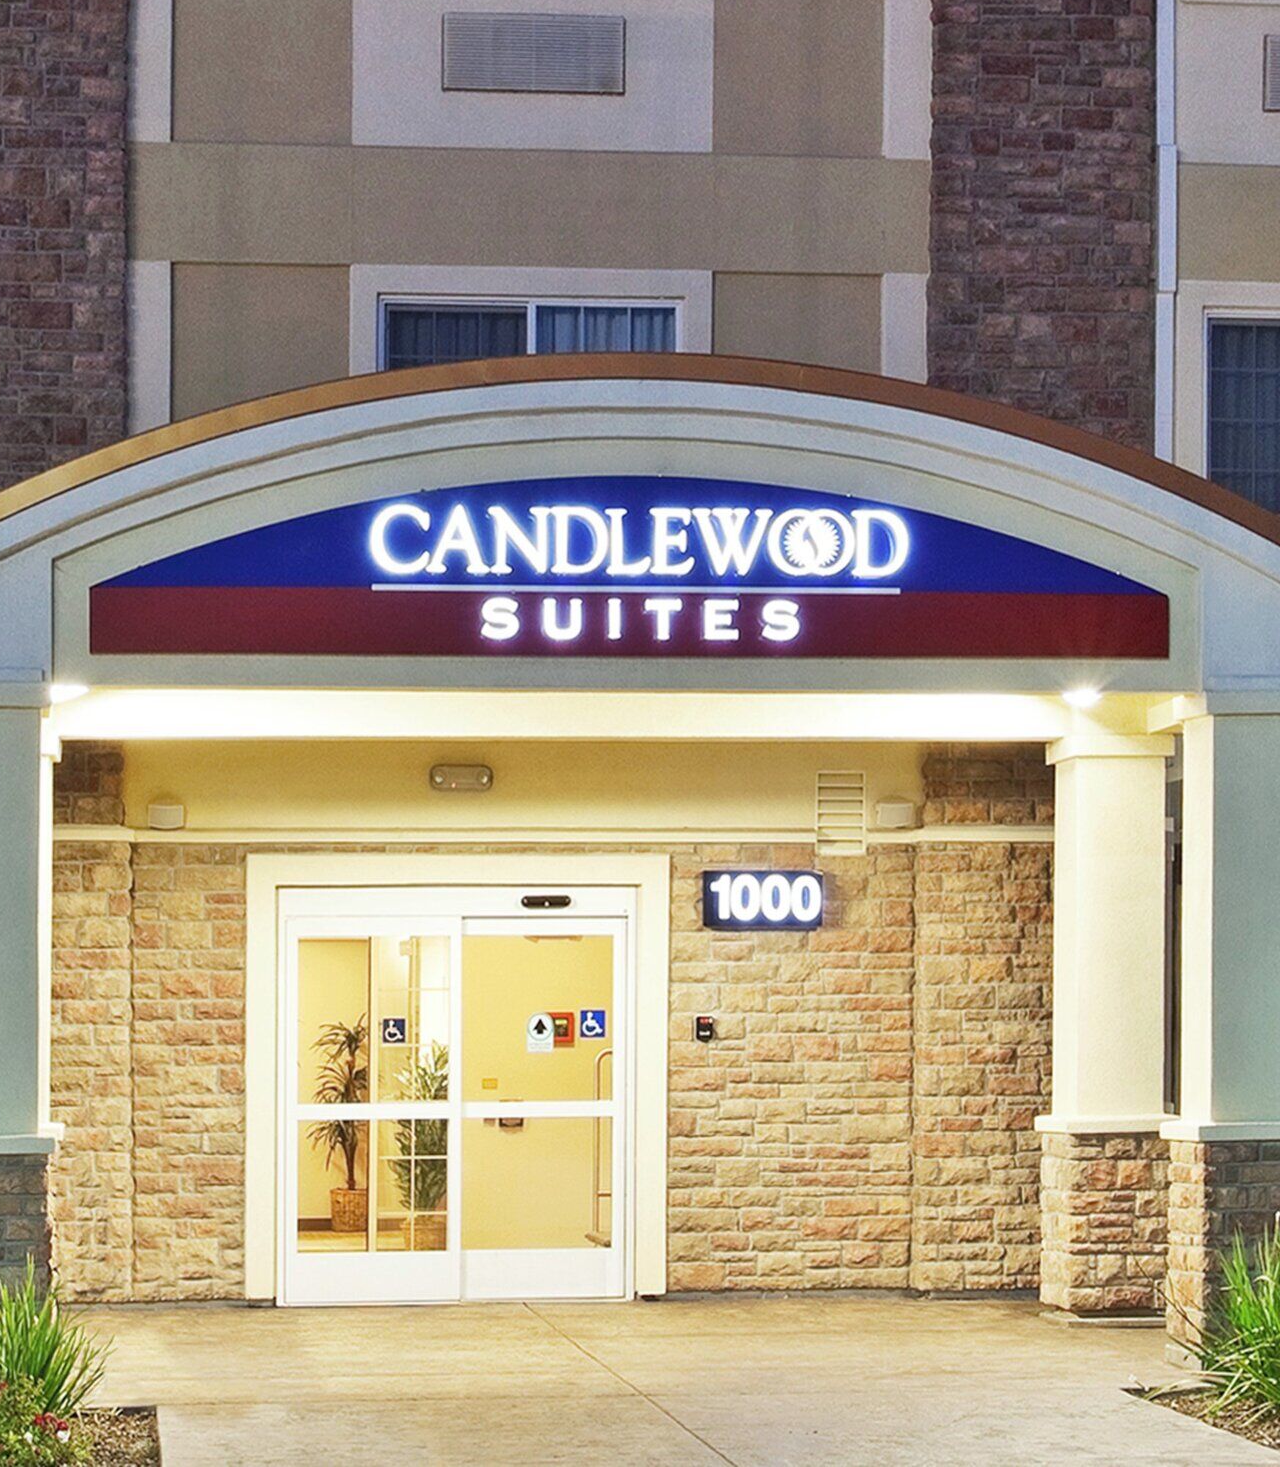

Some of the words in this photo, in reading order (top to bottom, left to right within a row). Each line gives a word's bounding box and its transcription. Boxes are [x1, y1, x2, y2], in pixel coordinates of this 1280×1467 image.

[369, 504, 908, 578] CANDLEWOOD
[480, 598, 800, 641] SUITES
[710, 874, 821, 921] 1000
